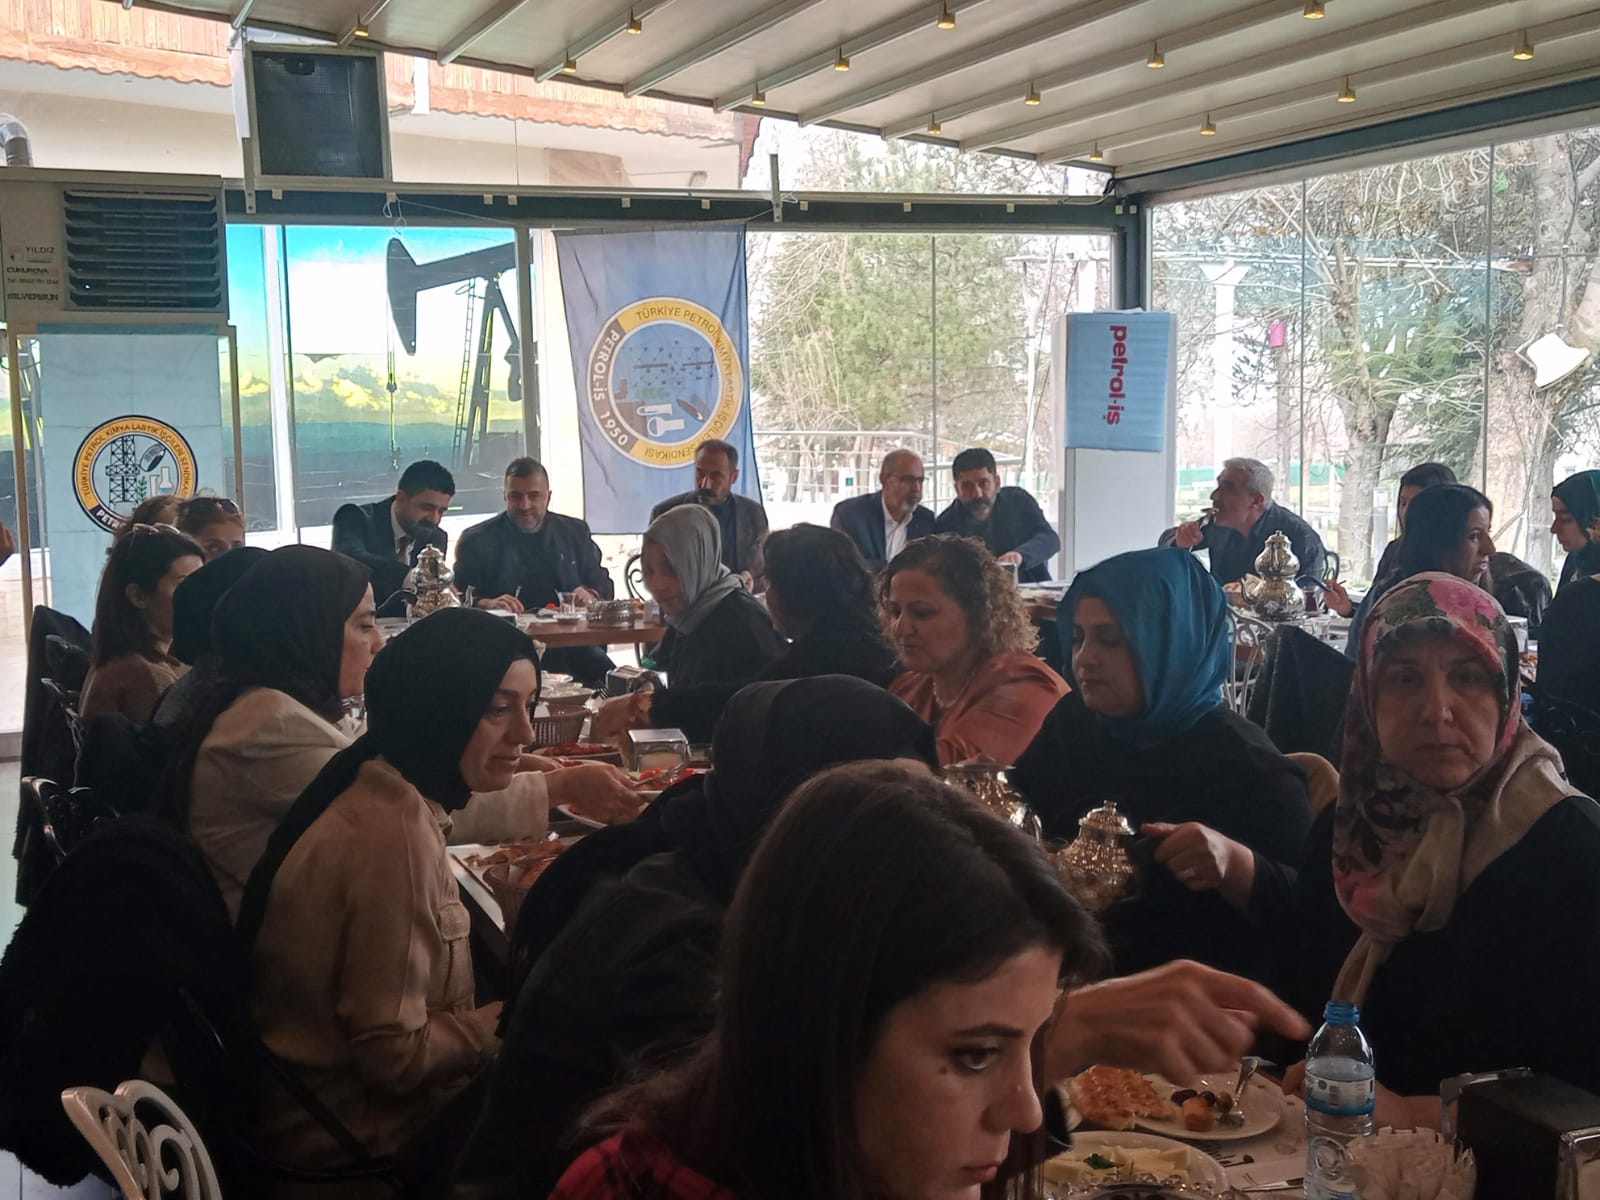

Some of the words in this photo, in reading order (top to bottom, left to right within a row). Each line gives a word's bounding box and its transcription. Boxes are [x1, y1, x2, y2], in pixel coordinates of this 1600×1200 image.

[25, 246, 55, 255] YILDIZ
[635, 305, 682, 320] TÜRKİYE
[684, 309, 719, 337] PETROL
[105, 423, 130, 436] KİMYA
[600, 410, 628, 446] 1950
[84, 434, 107, 462] PETROL
[80, 462, 91, 496] TÜRKİYE
